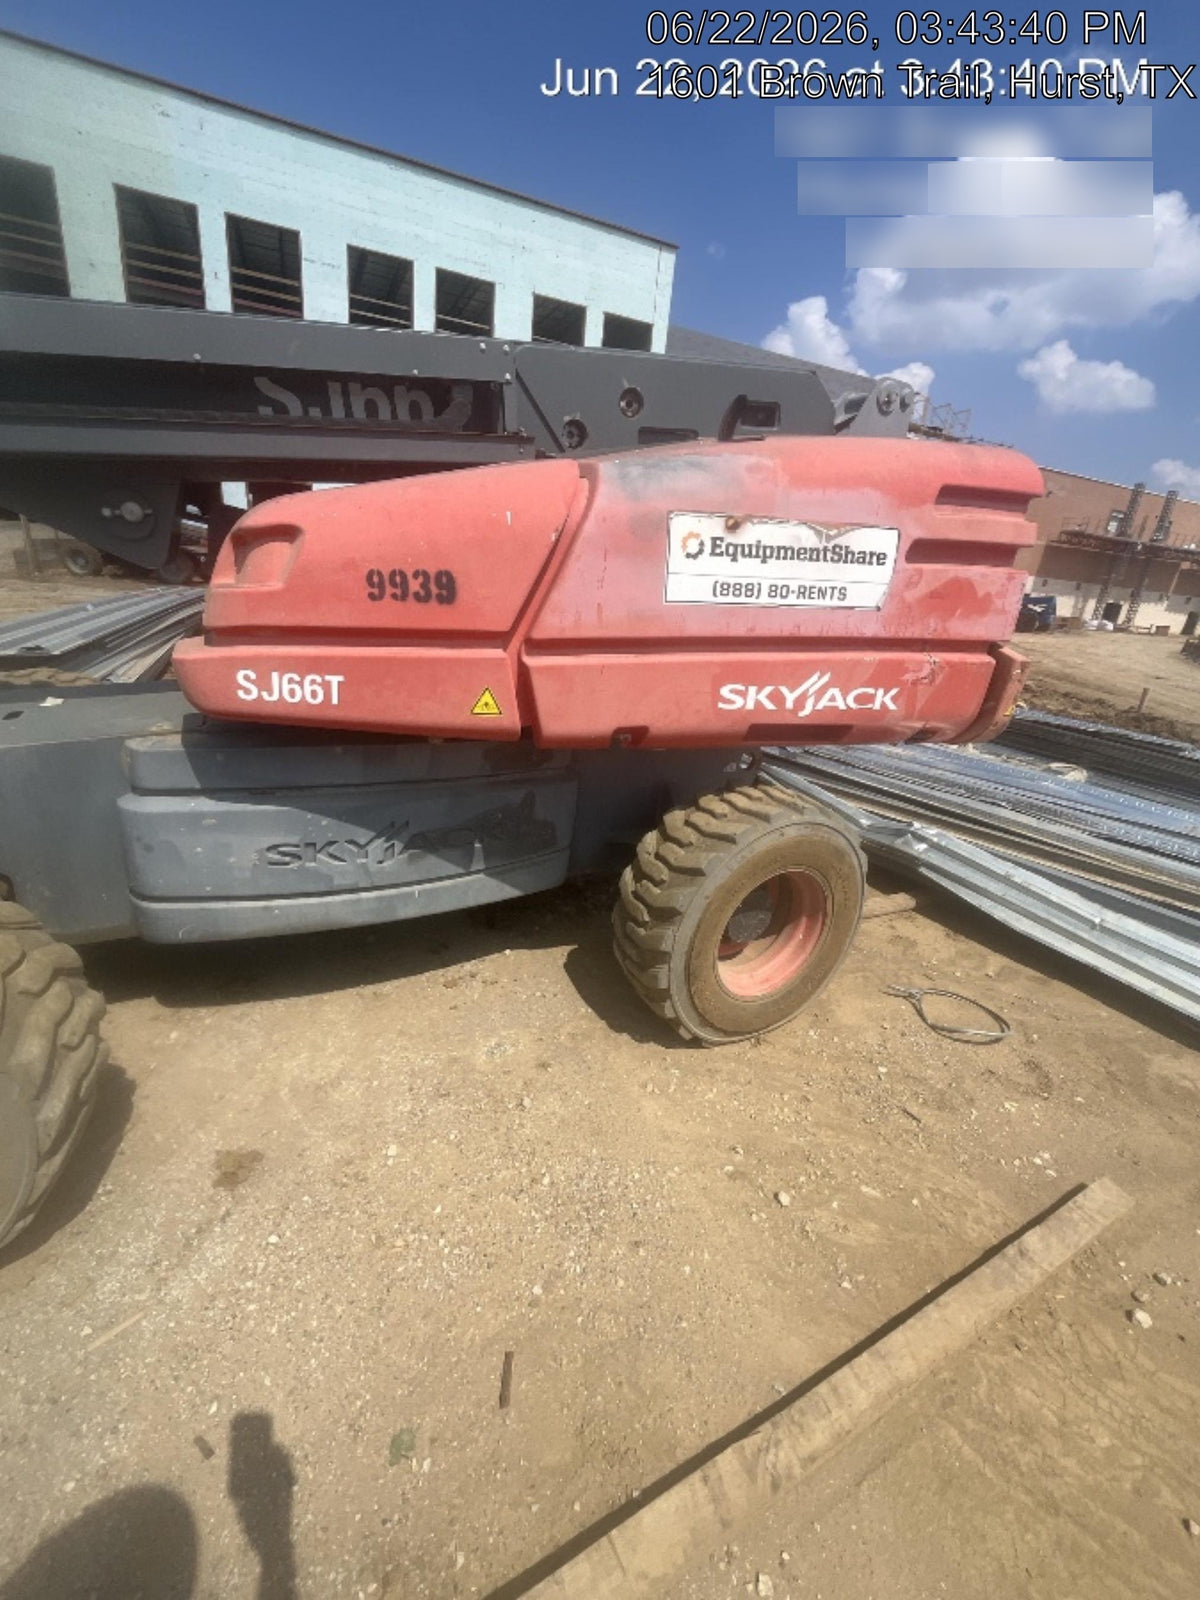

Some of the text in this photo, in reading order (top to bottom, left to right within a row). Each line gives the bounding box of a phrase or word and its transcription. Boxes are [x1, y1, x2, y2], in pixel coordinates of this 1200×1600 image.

[709, 536, 888, 567] EquipmentShare
[365, 568, 458, 605] 9939
[712, 580, 848, 602] (888) 80-RENTS
[236, 669, 345, 705] SJ66T
[717, 671, 900, 718] SKYJACK
